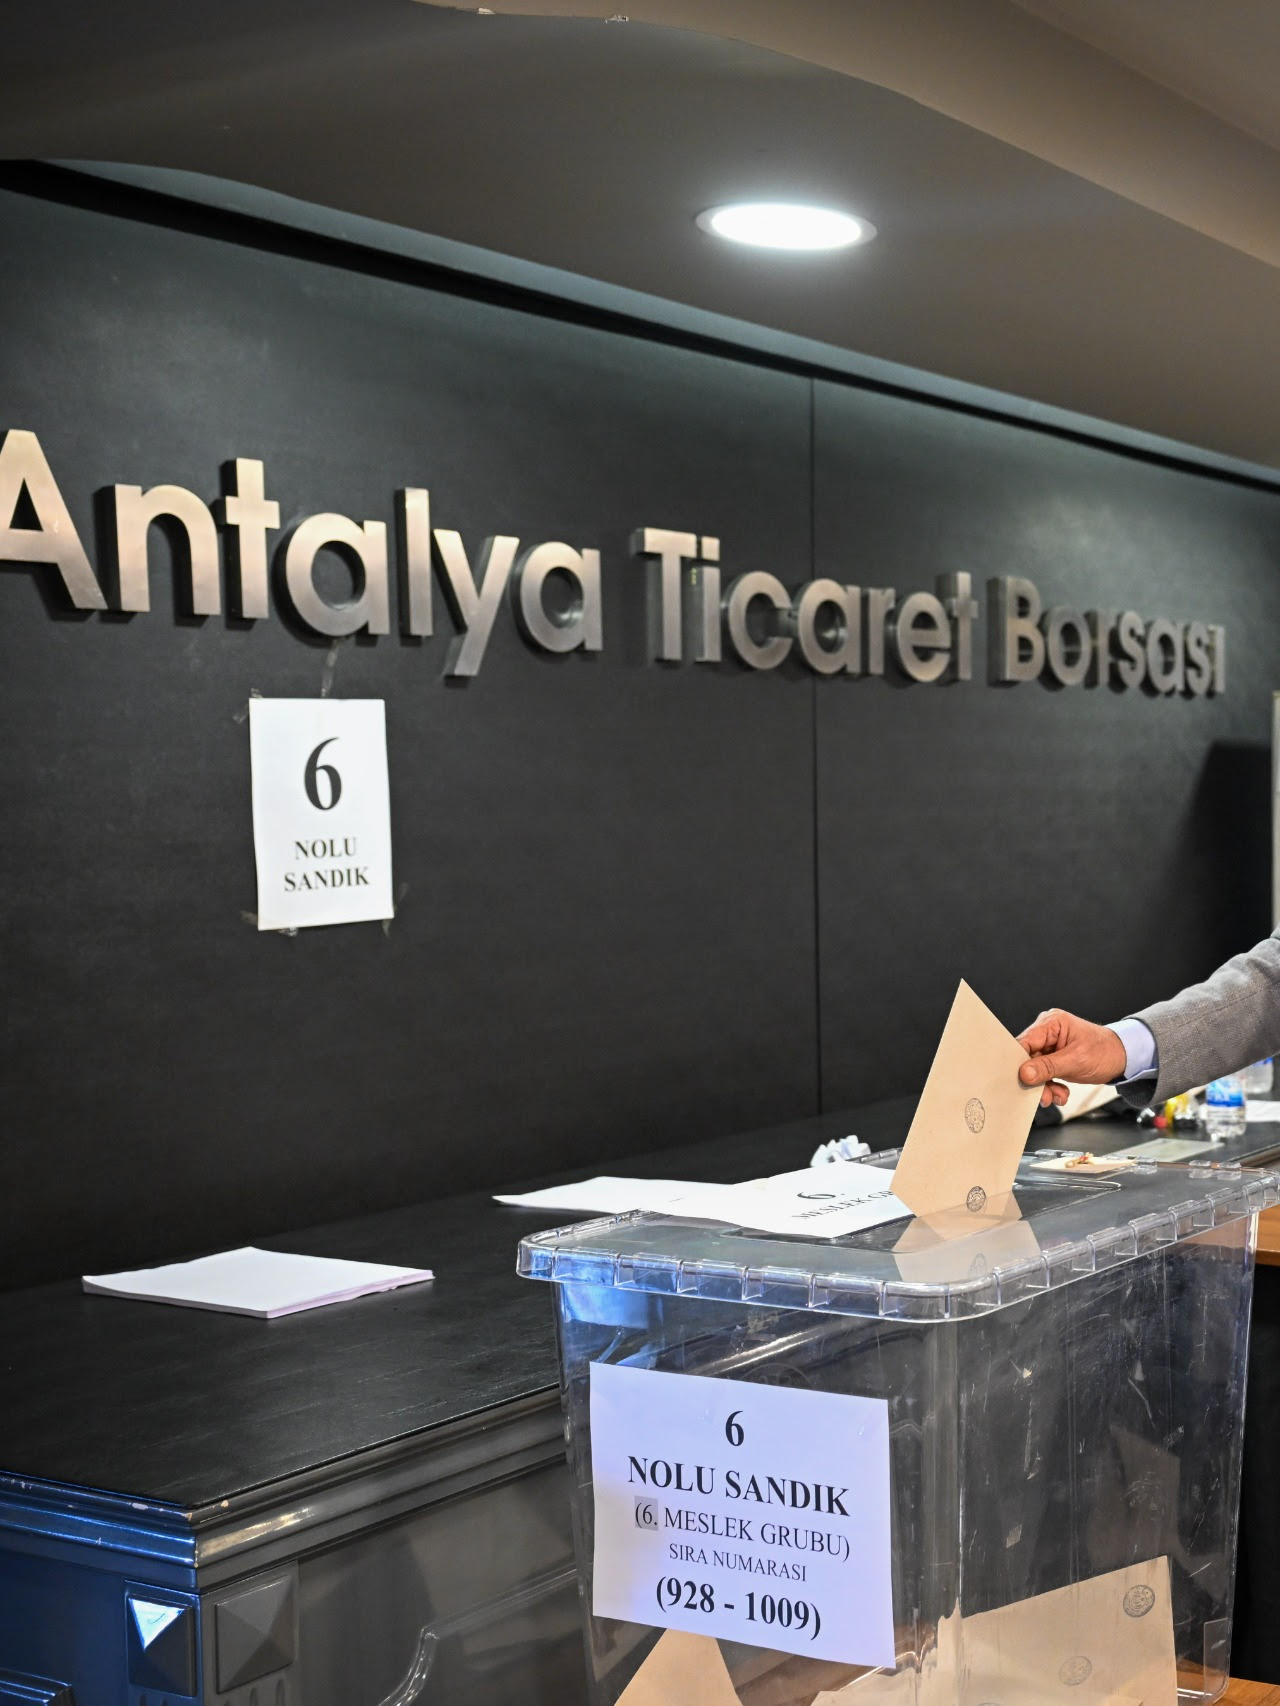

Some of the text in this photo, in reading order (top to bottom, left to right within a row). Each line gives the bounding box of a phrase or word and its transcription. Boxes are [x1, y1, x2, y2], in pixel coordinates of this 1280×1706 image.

[0, 429, 1225, 695] Antalya Ticaret Borsası
[304, 737, 342, 810] 6
[294, 837, 357, 860] NOLU
[284, 866, 370, 892] SANDIK
[725, 1410, 745, 1447] 6
[627, 1455, 851, 1517] NOLU SANDIK
[635, 1502, 850, 1562] (6. MESLEK GRUBU)
[668, 1543, 807, 1582] SIRA NUMARASI
[656, 1576, 716, 1613] (928
[744, 1591, 821, 1641] 1009)
